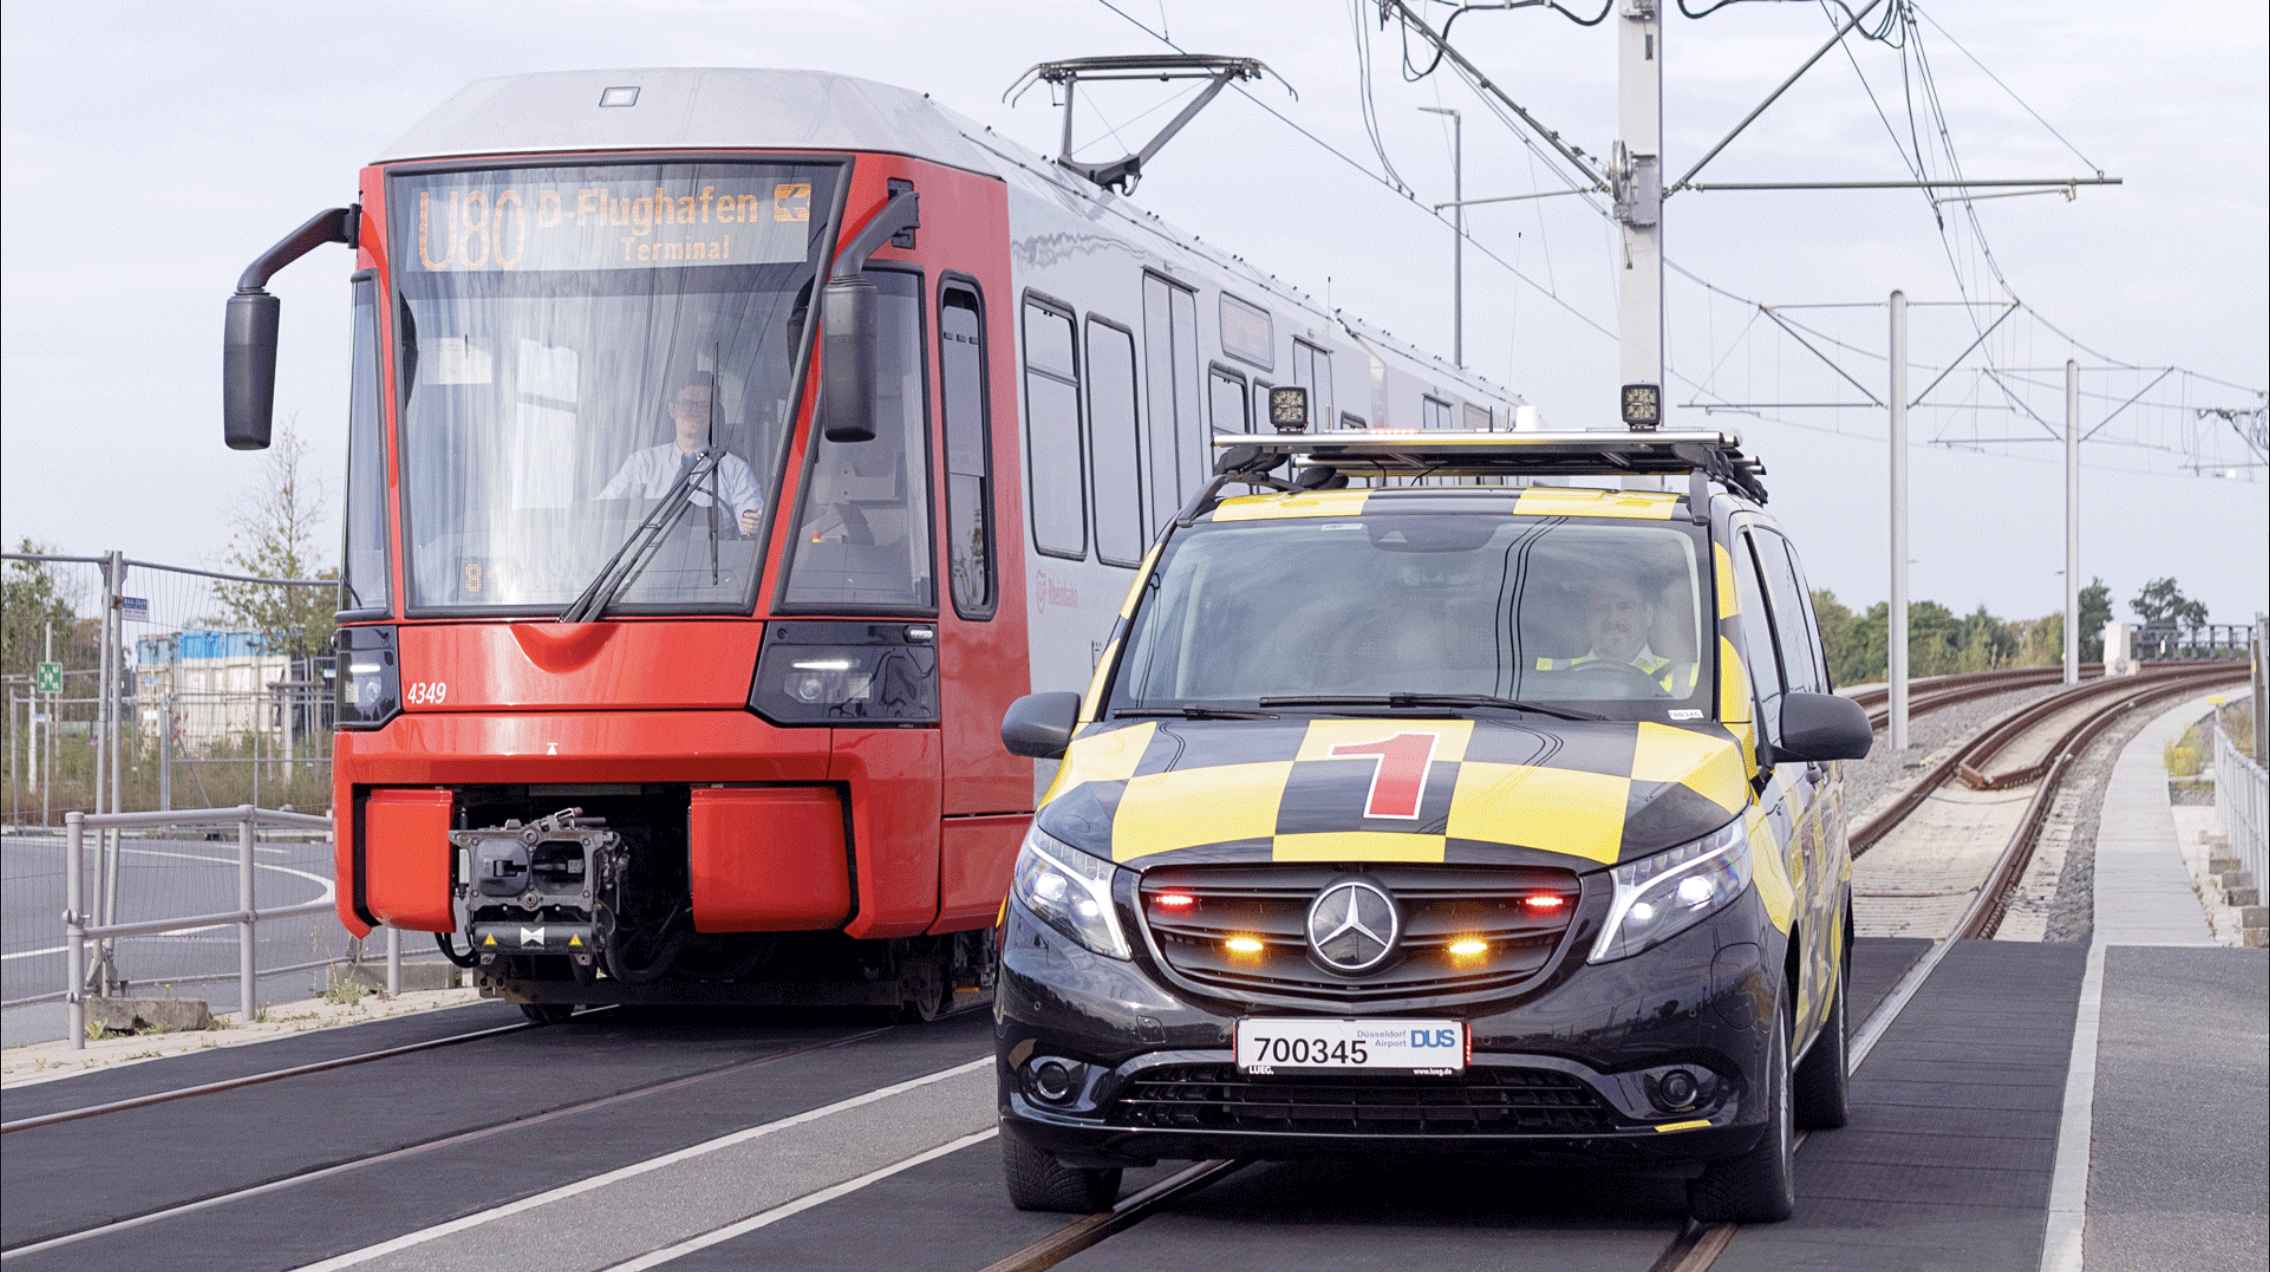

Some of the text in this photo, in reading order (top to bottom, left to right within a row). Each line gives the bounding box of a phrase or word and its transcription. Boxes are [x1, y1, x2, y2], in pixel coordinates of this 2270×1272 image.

[419, 185, 758, 271] U80 D-Flughafen
[620, 235, 730, 262] Terminal
[407, 682, 447, 705] 4349
[1327, 731, 1441, 821] 1
[1253, 1037, 1368, 1065] 700345
[1356, 1029, 1456, 1048] Düsseldorf DUS
[1375, 1039, 1407, 1048] Airport
[1413, 1068, 1452, 1077] www.lueg.de
